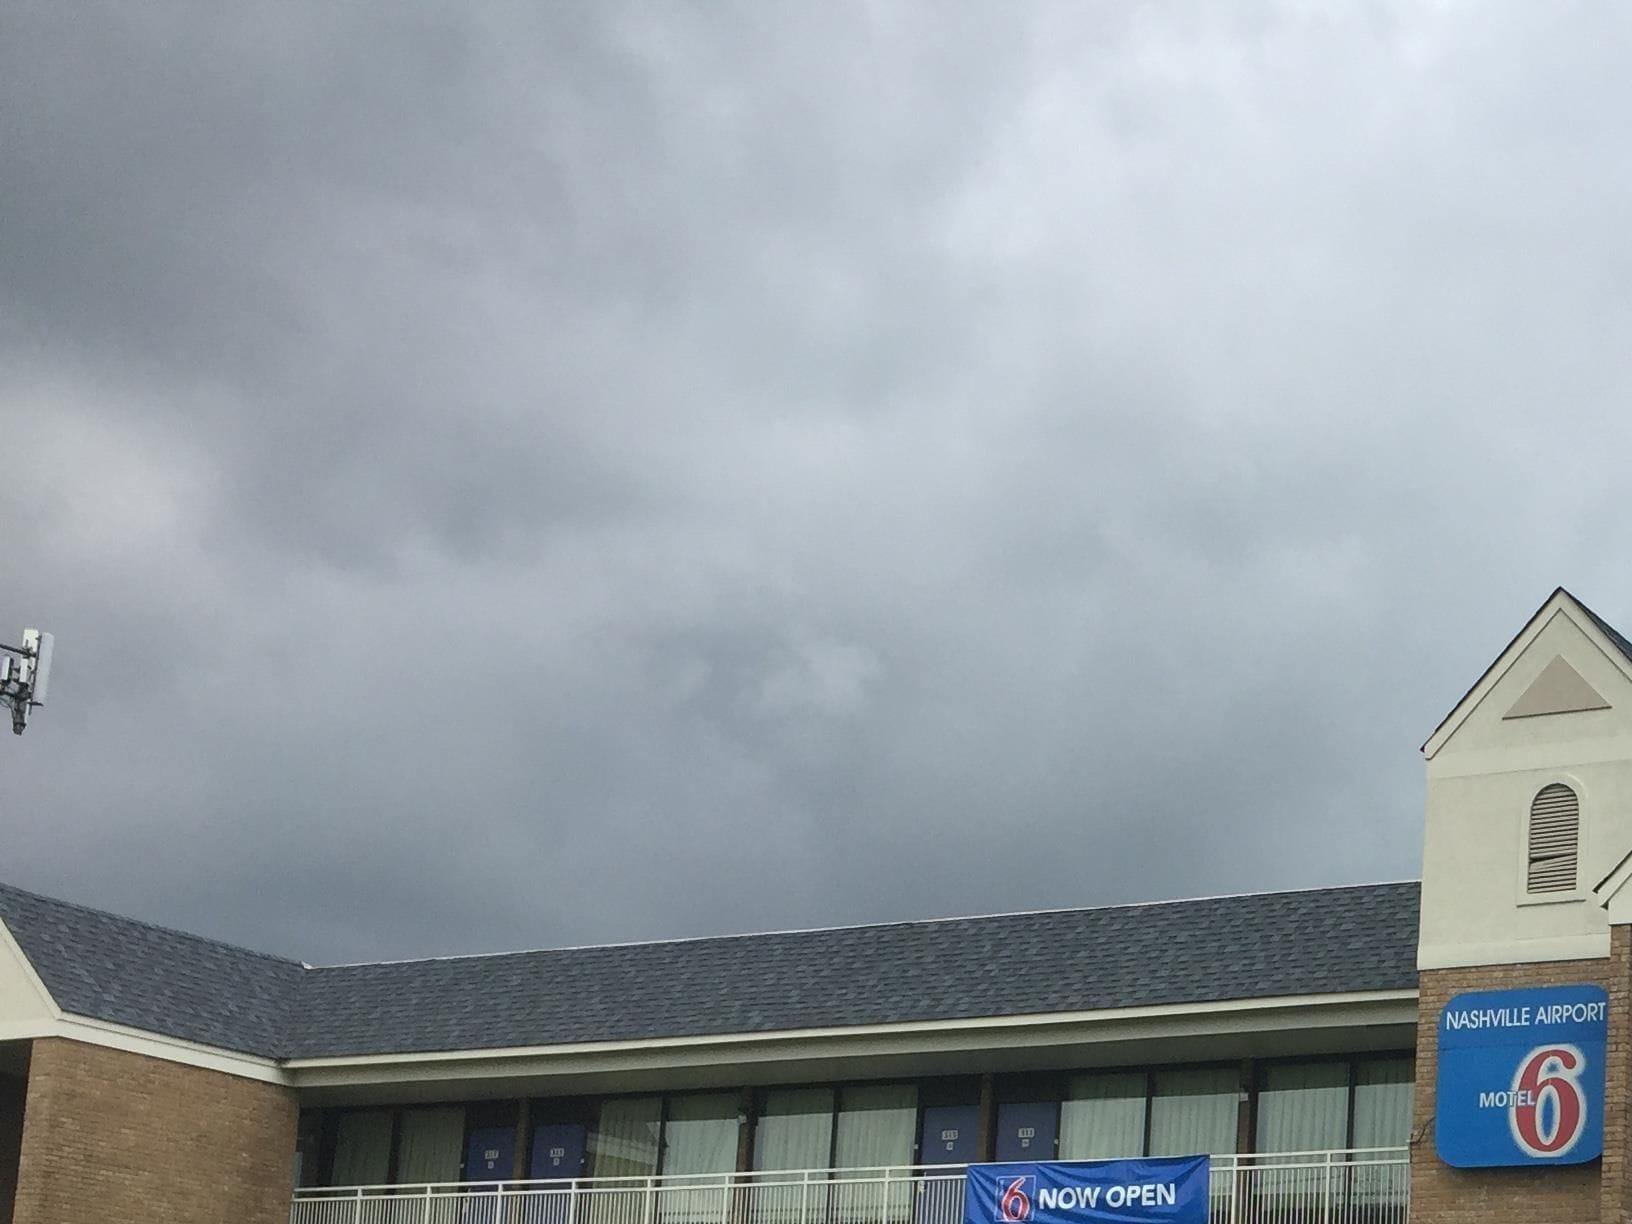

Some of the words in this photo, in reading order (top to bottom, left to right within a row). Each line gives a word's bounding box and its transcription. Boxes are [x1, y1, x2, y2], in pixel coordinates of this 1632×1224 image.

[1446, 1007, 1530, 1030] NASHVILLE
[1535, 1002, 1606, 1025] AIRPORT
[1479, 1090, 1536, 1108] MOTEL
[1512, 1046, 1583, 1155] 6
[1001, 1176, 1031, 1222] 6
[1039, 1187, 1101, 1210] NOW
[1106, 1183, 1176, 1208] OPEN
